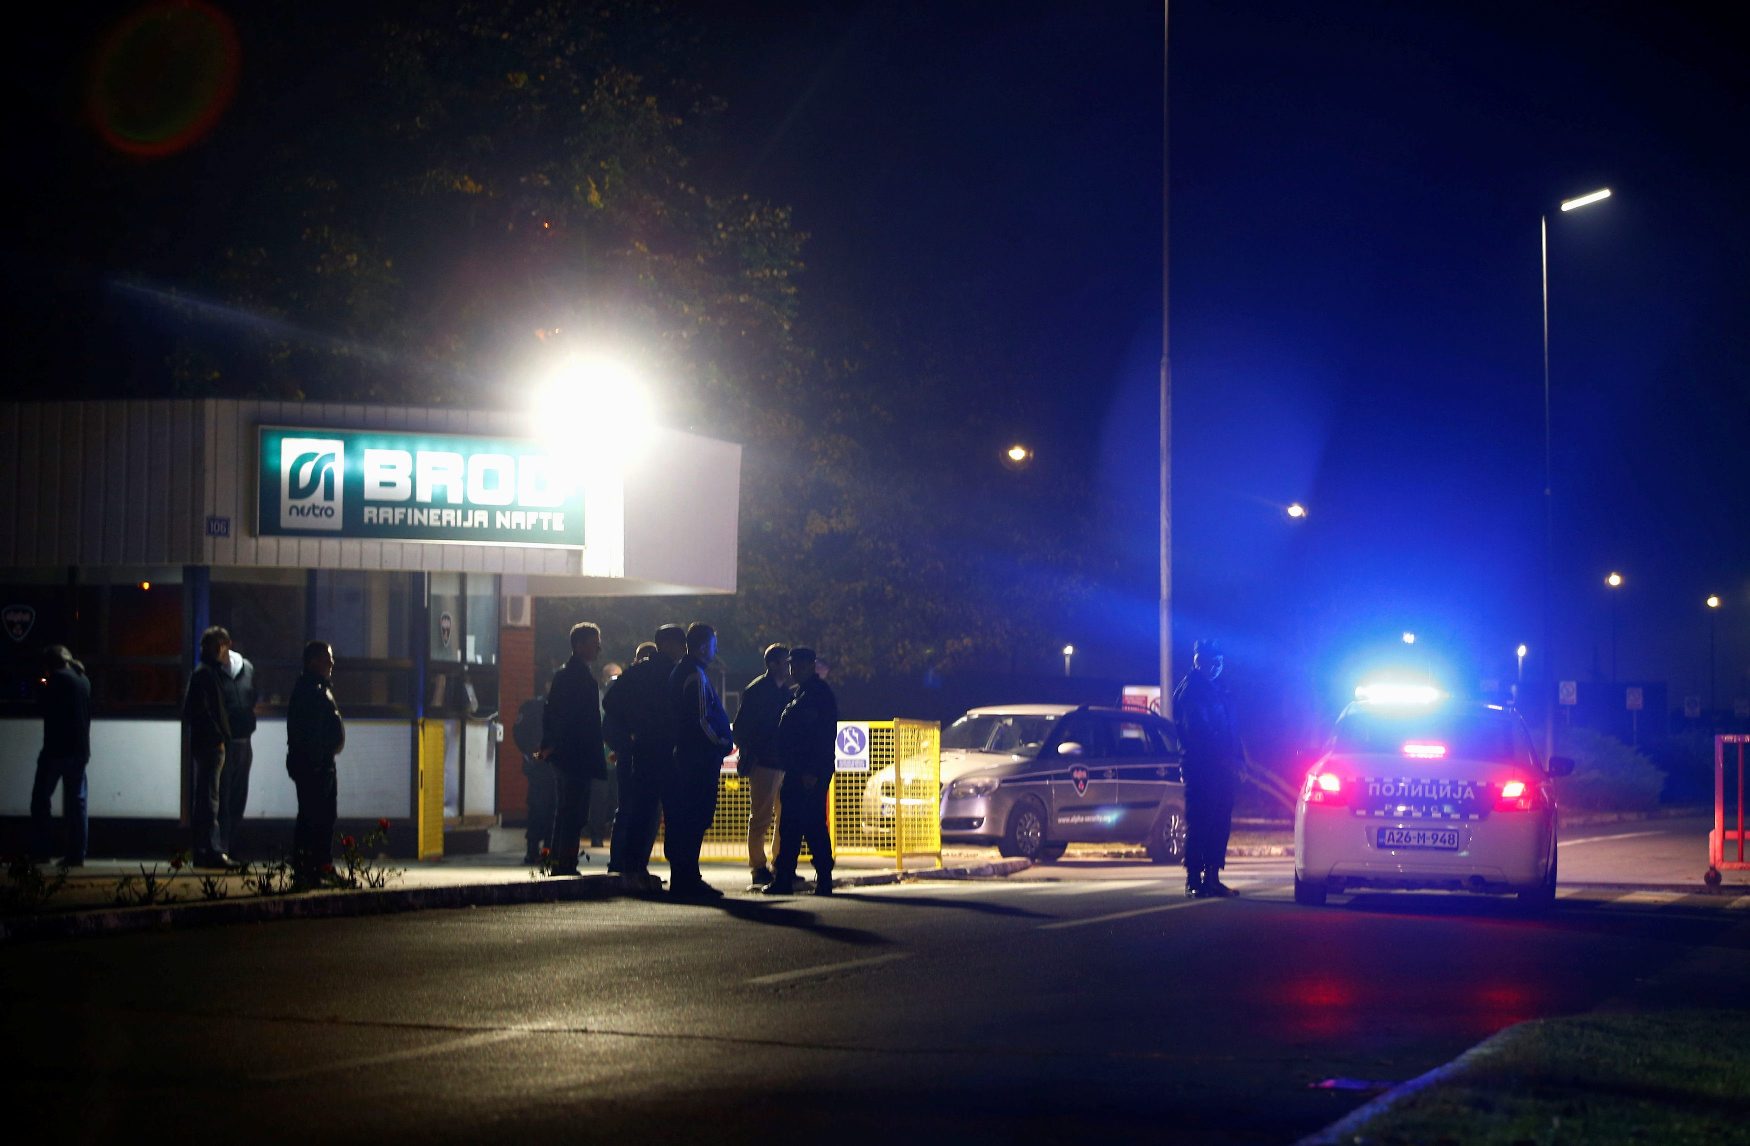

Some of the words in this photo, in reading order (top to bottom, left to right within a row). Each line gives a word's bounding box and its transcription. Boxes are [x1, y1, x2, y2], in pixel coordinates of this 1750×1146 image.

[363, 448, 568, 508] BROD
[289, 503, 335, 518] nestro
[363, 507, 489, 528] RAFINERIJA
[496, 511, 565, 531] NAFTE
[1368, 783, 1475, 799] ПОЛИЦИЈА
[1384, 804, 1453, 813] PLIC
[1386, 831, 1456, 846] A26-M-948
